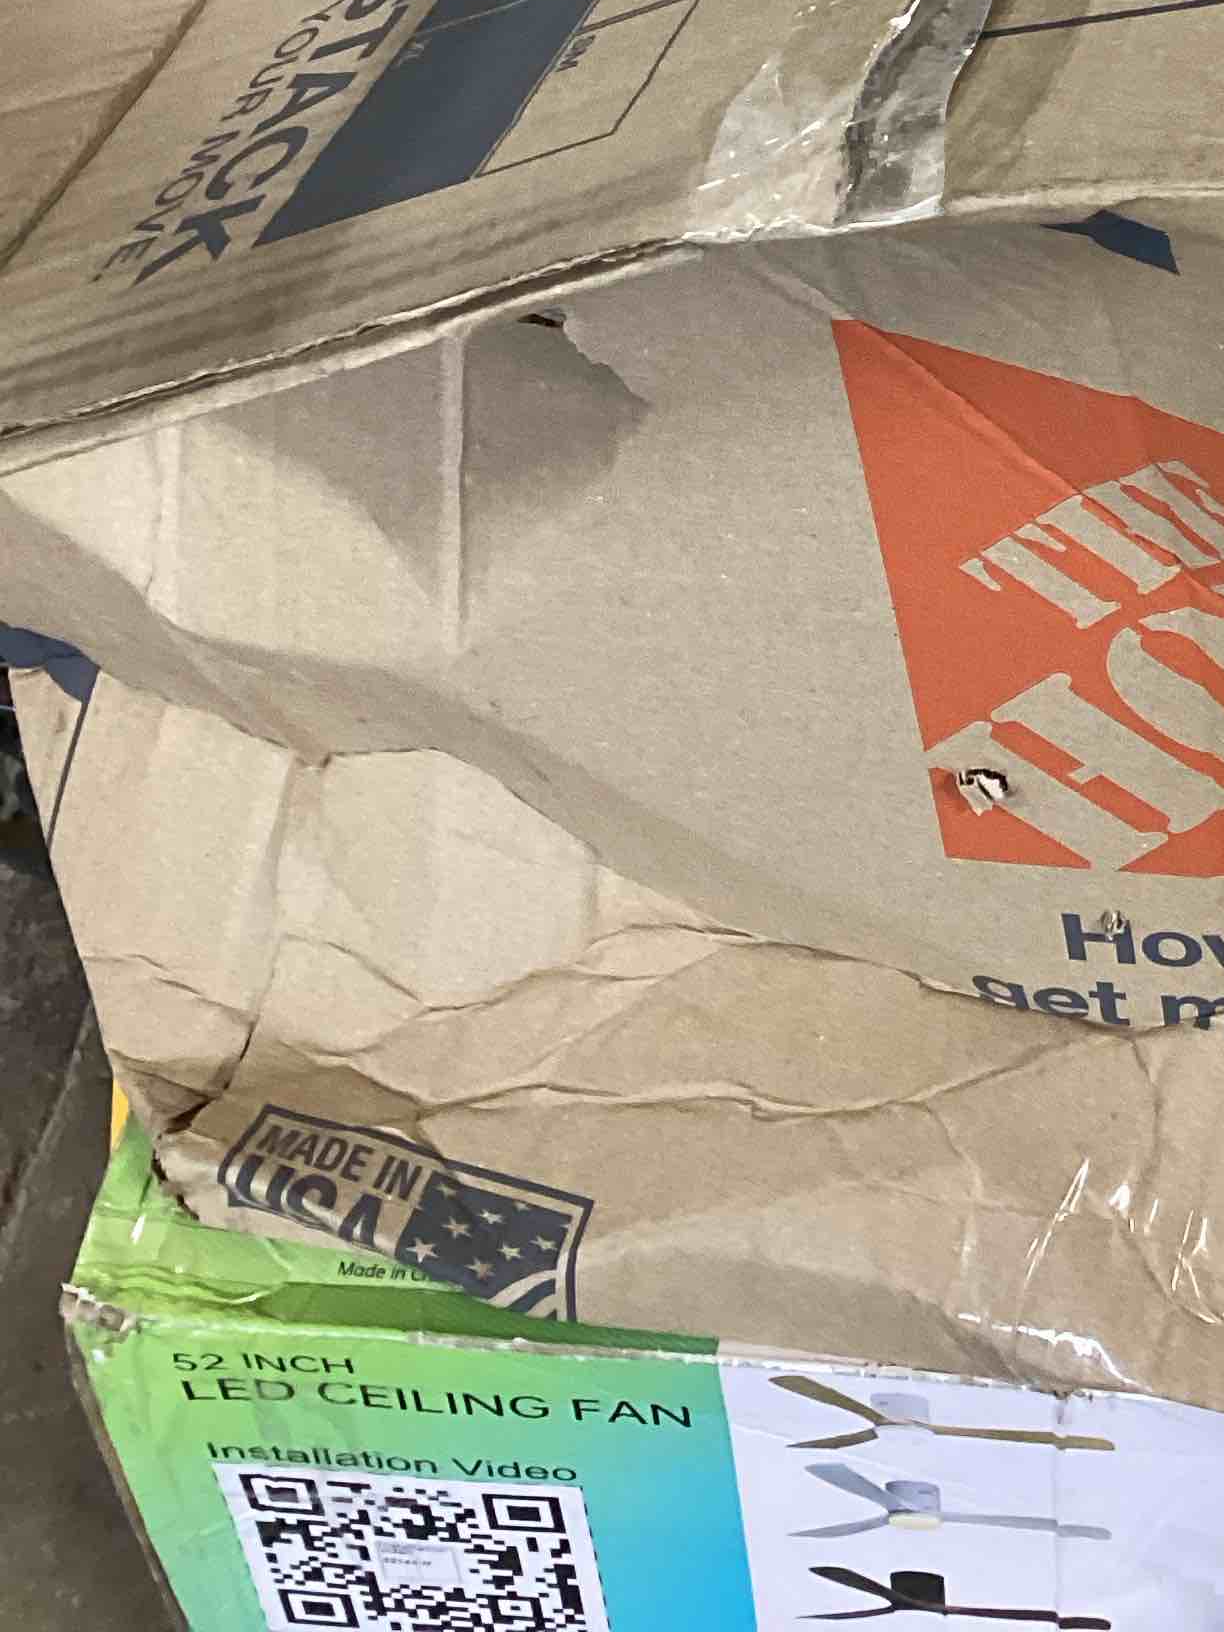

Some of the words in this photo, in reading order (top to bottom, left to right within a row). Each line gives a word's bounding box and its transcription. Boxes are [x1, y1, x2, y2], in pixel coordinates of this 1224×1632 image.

[90, 129, 241, 284] MOVE.
[972, 974, 1131, 1028] get
[256, 1123, 374, 1185] MADE
[373, 1154, 424, 1202] IN
[228, 1154, 383, 1250] USA
[338, 1261, 386, 1279] Made
[390, 1263, 407, 1281] in
[172, 1352, 225, 1373] 52
[244, 1353, 355, 1375] INCH
[181, 1378, 297, 1404] LED
[318, 1382, 551, 1421] CEILING
[569, 1399, 694, 1430] FAN
[207, 1441, 438, 1475] Installation
[452, 1457, 579, 1483] Video
